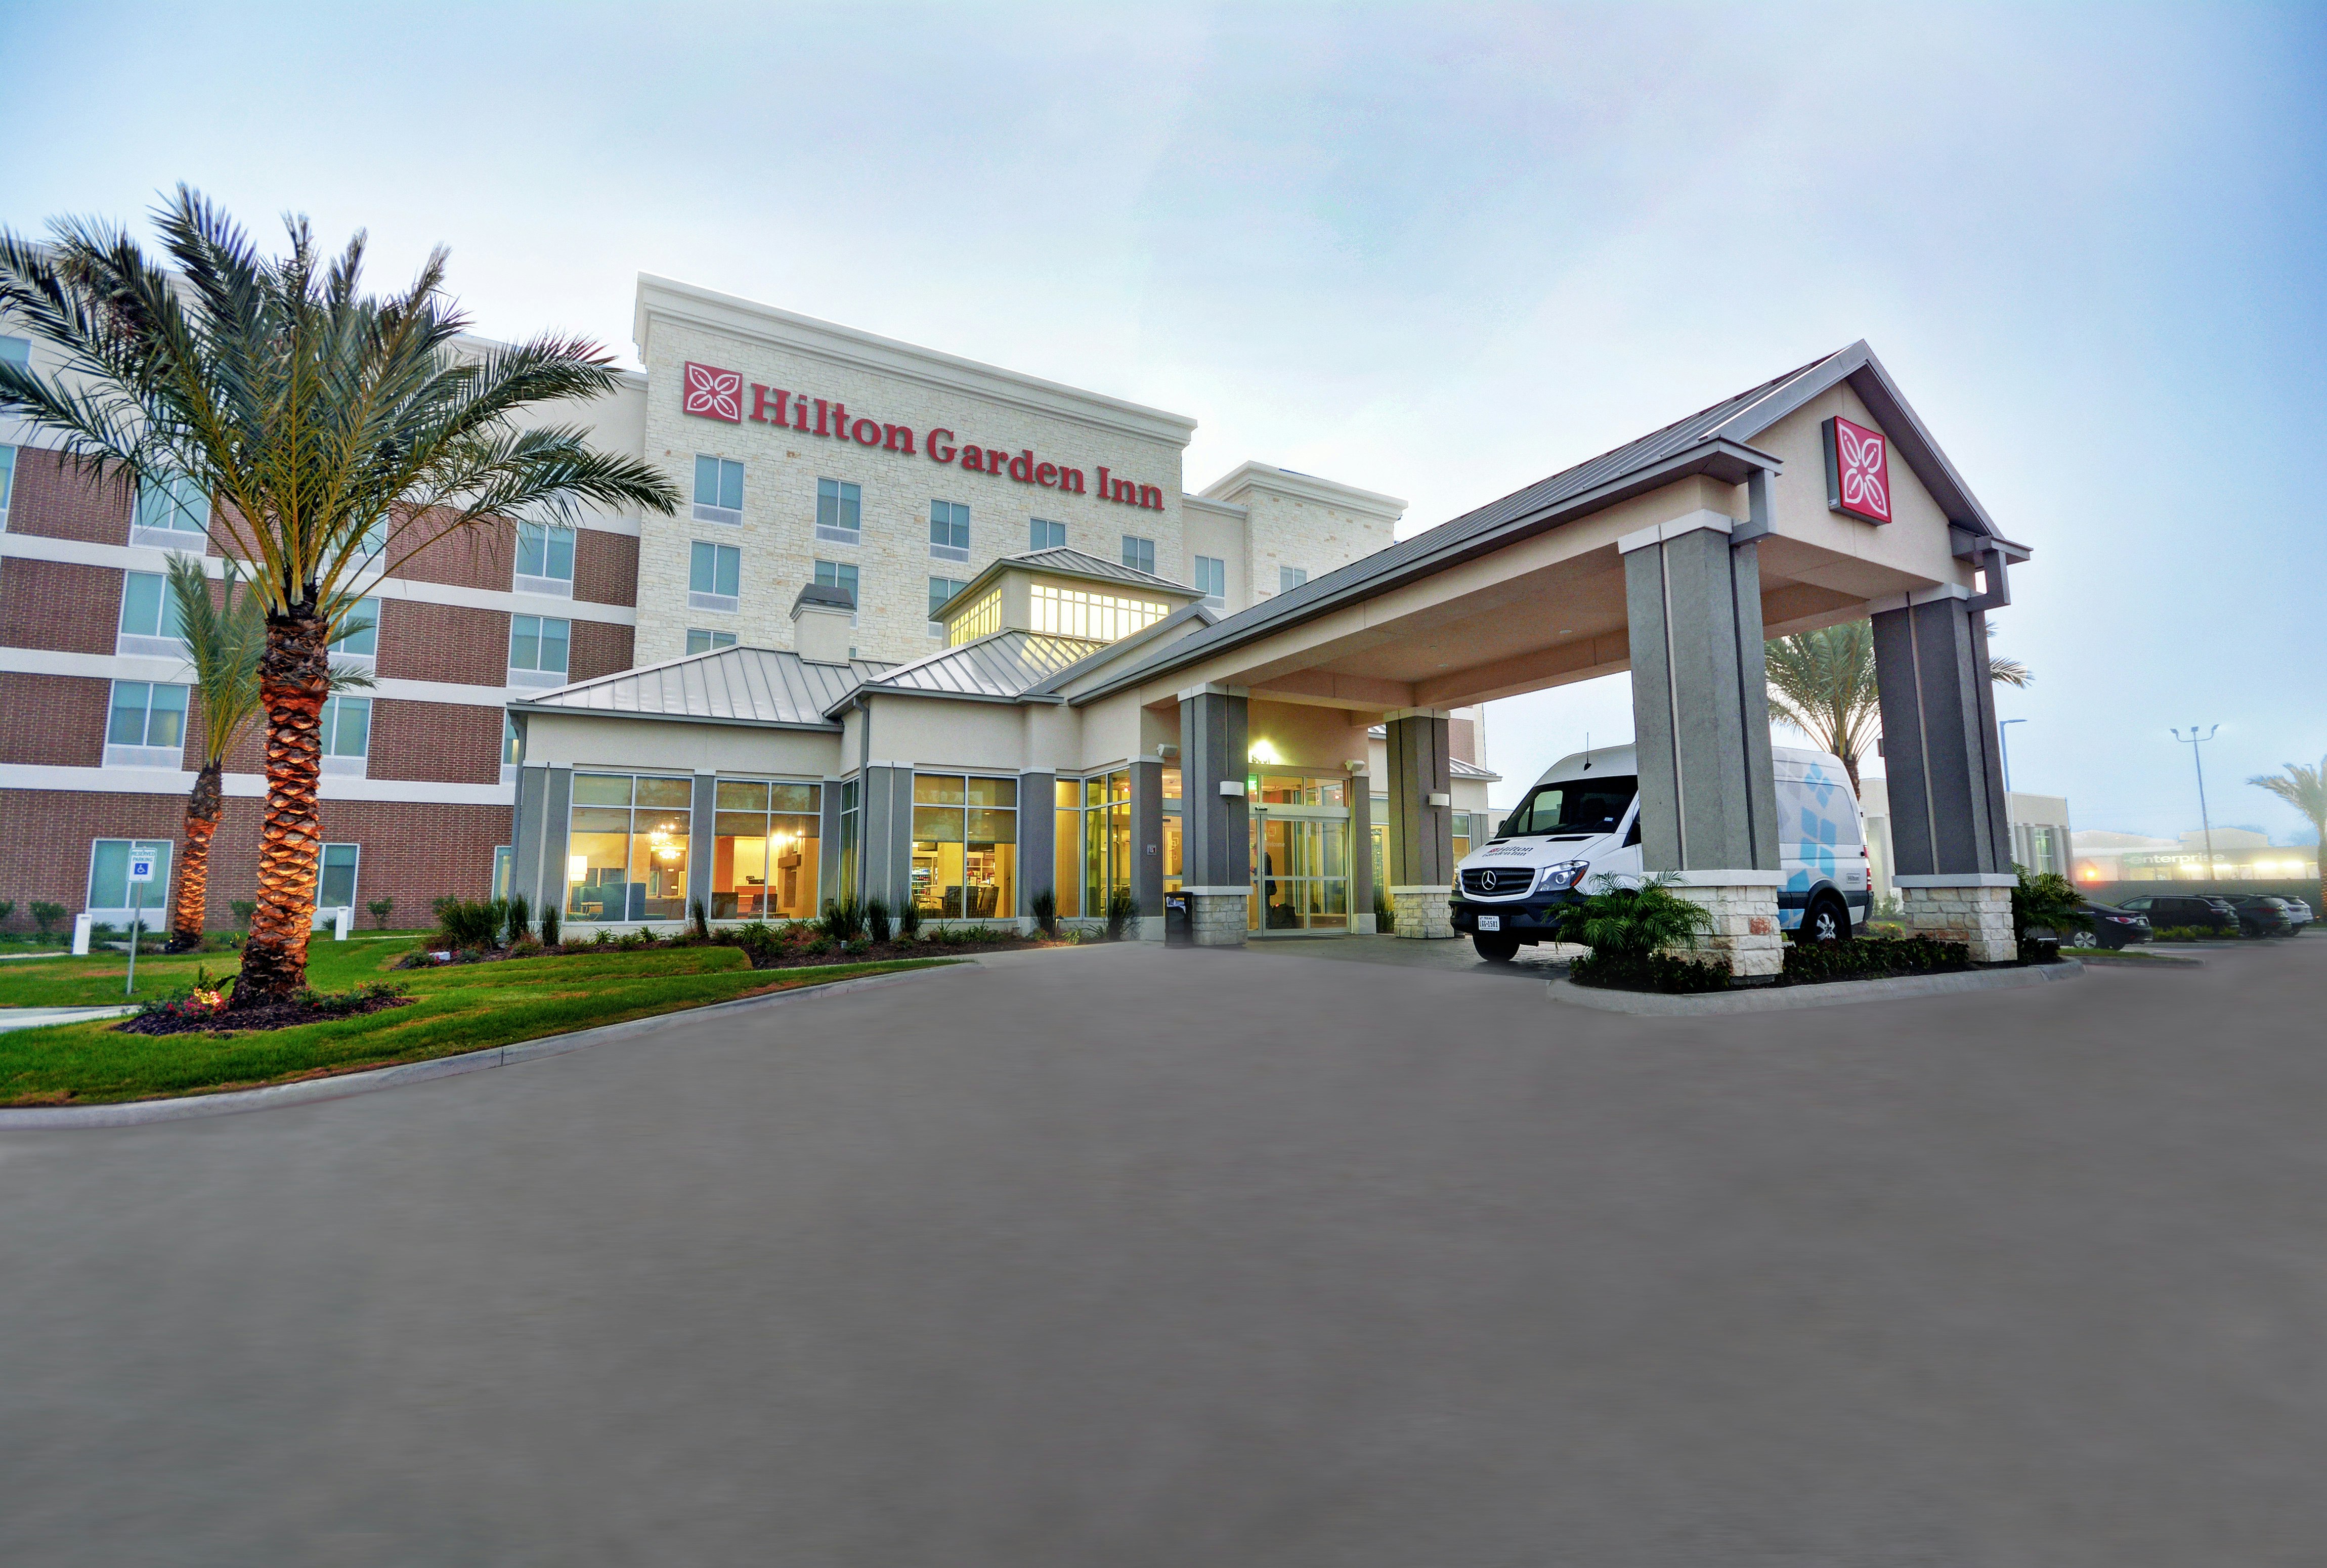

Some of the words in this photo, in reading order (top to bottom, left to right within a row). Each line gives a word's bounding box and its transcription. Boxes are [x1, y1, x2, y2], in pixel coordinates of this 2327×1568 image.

[749, 382, 916, 454] Hilton
[927, 428, 1086, 494] Garden
[1097, 466, 1165, 511] Inn
[2130, 852, 2225, 864] enterprise
